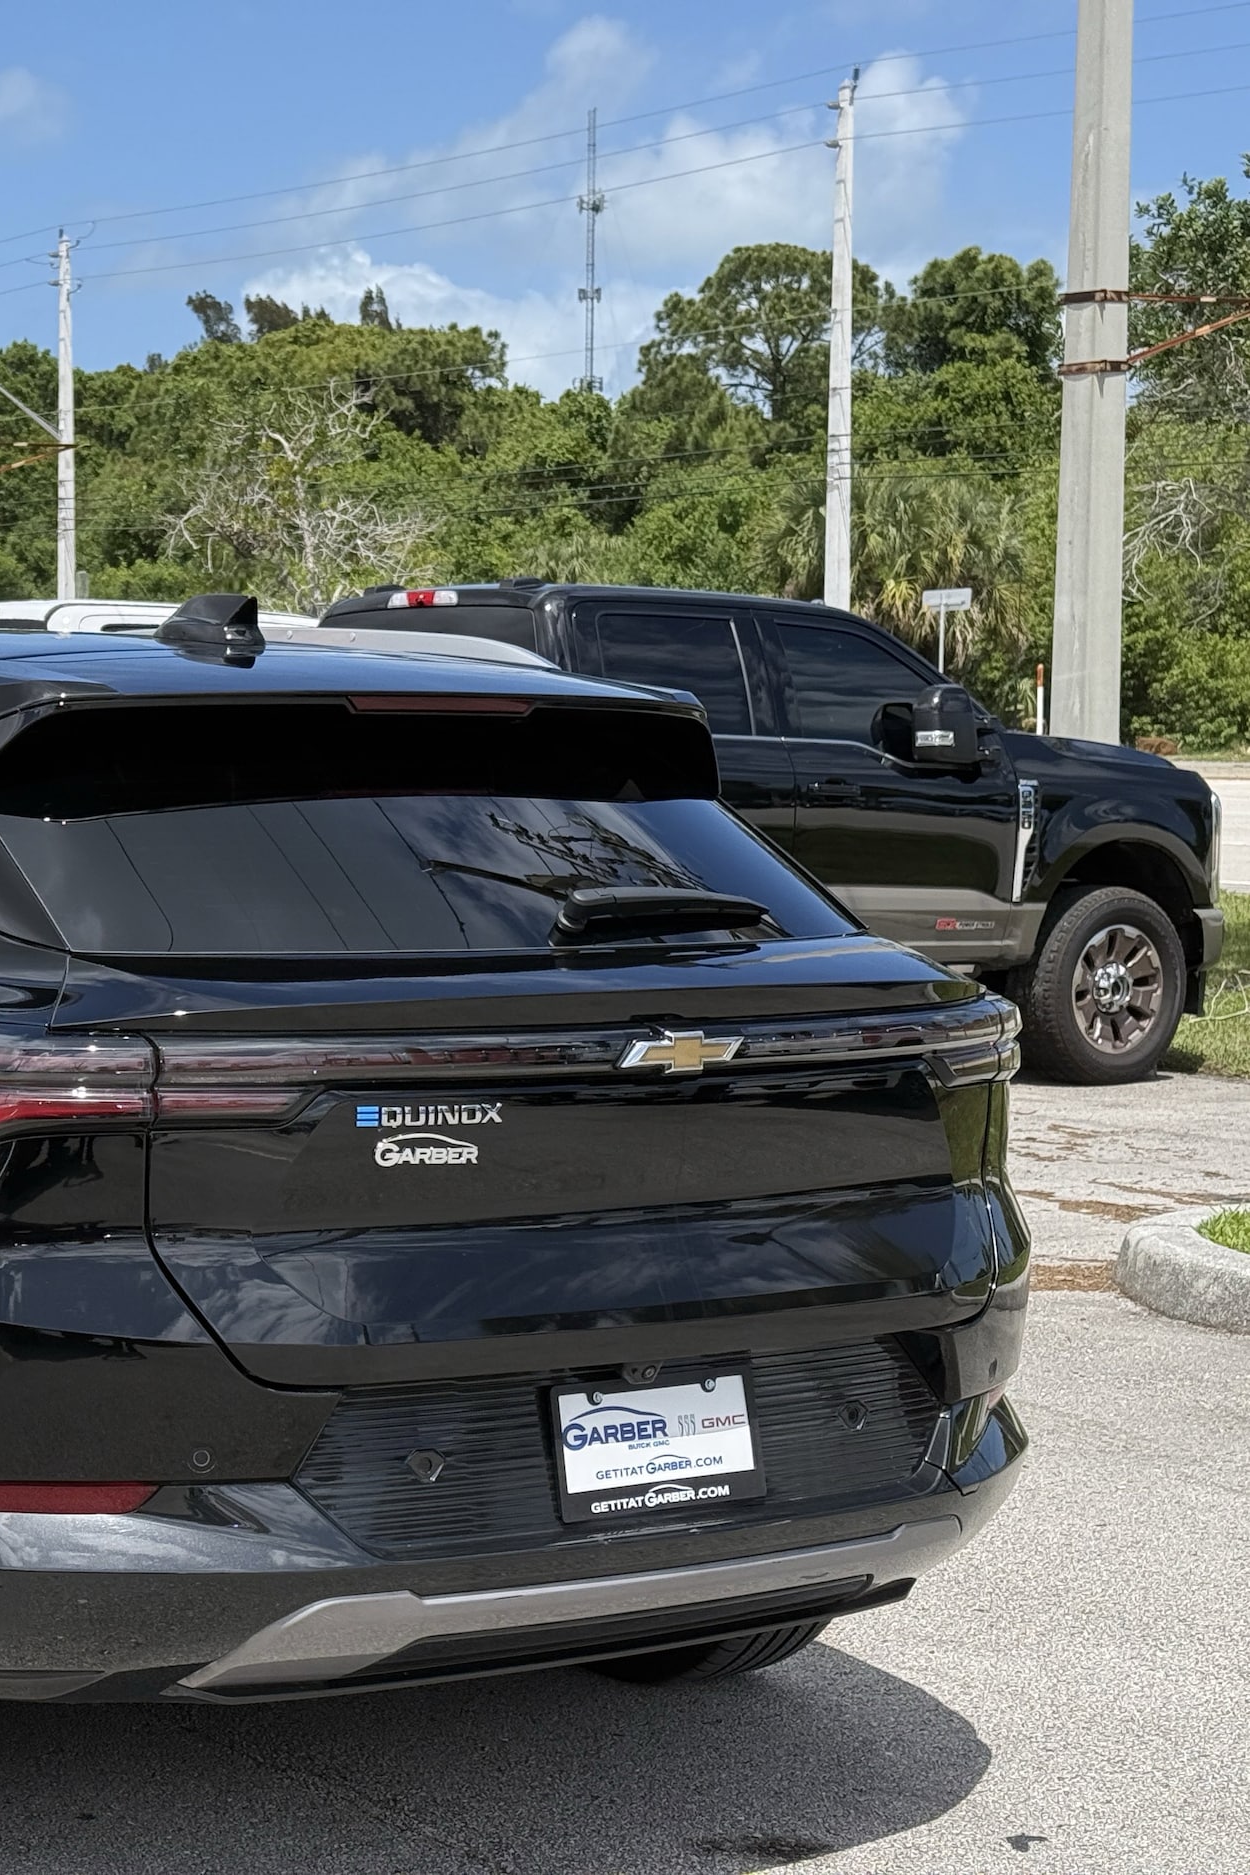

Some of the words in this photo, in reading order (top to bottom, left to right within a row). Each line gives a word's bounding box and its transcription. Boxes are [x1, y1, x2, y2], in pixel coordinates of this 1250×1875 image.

[355, 1102, 503, 1128] EQUINOX
[374, 1139, 479, 1167] GARBER
[562, 1418, 669, 1451] GARBER
[701, 1413, 747, 1430] GMC
[627, 1442, 652, 1451] BUICK
[652, 1439, 671, 1448] GMC
